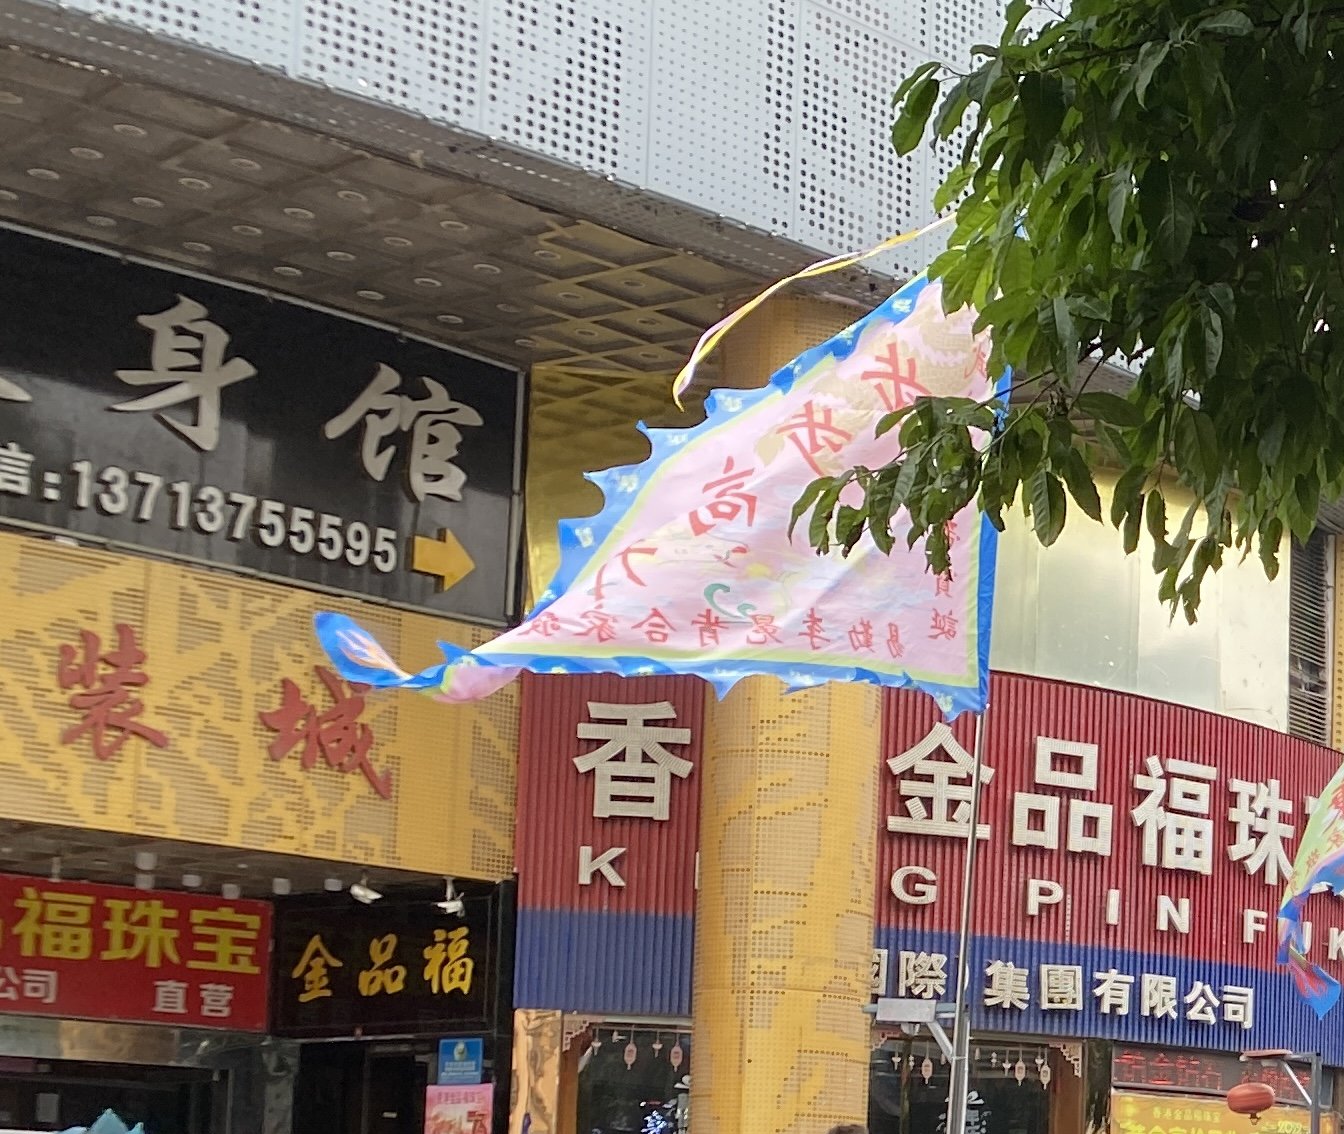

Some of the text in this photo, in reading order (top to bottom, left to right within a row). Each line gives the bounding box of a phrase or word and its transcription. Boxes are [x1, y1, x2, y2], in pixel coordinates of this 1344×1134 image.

[0, 294, 484, 502] 身馆
[573, 700, 694, 822] 香
[578, 846, 627, 890] K
[890, 865, 938, 906] G
[152, 978, 236, 1019] 直营
[291, 925, 476, 1003] 金品福
